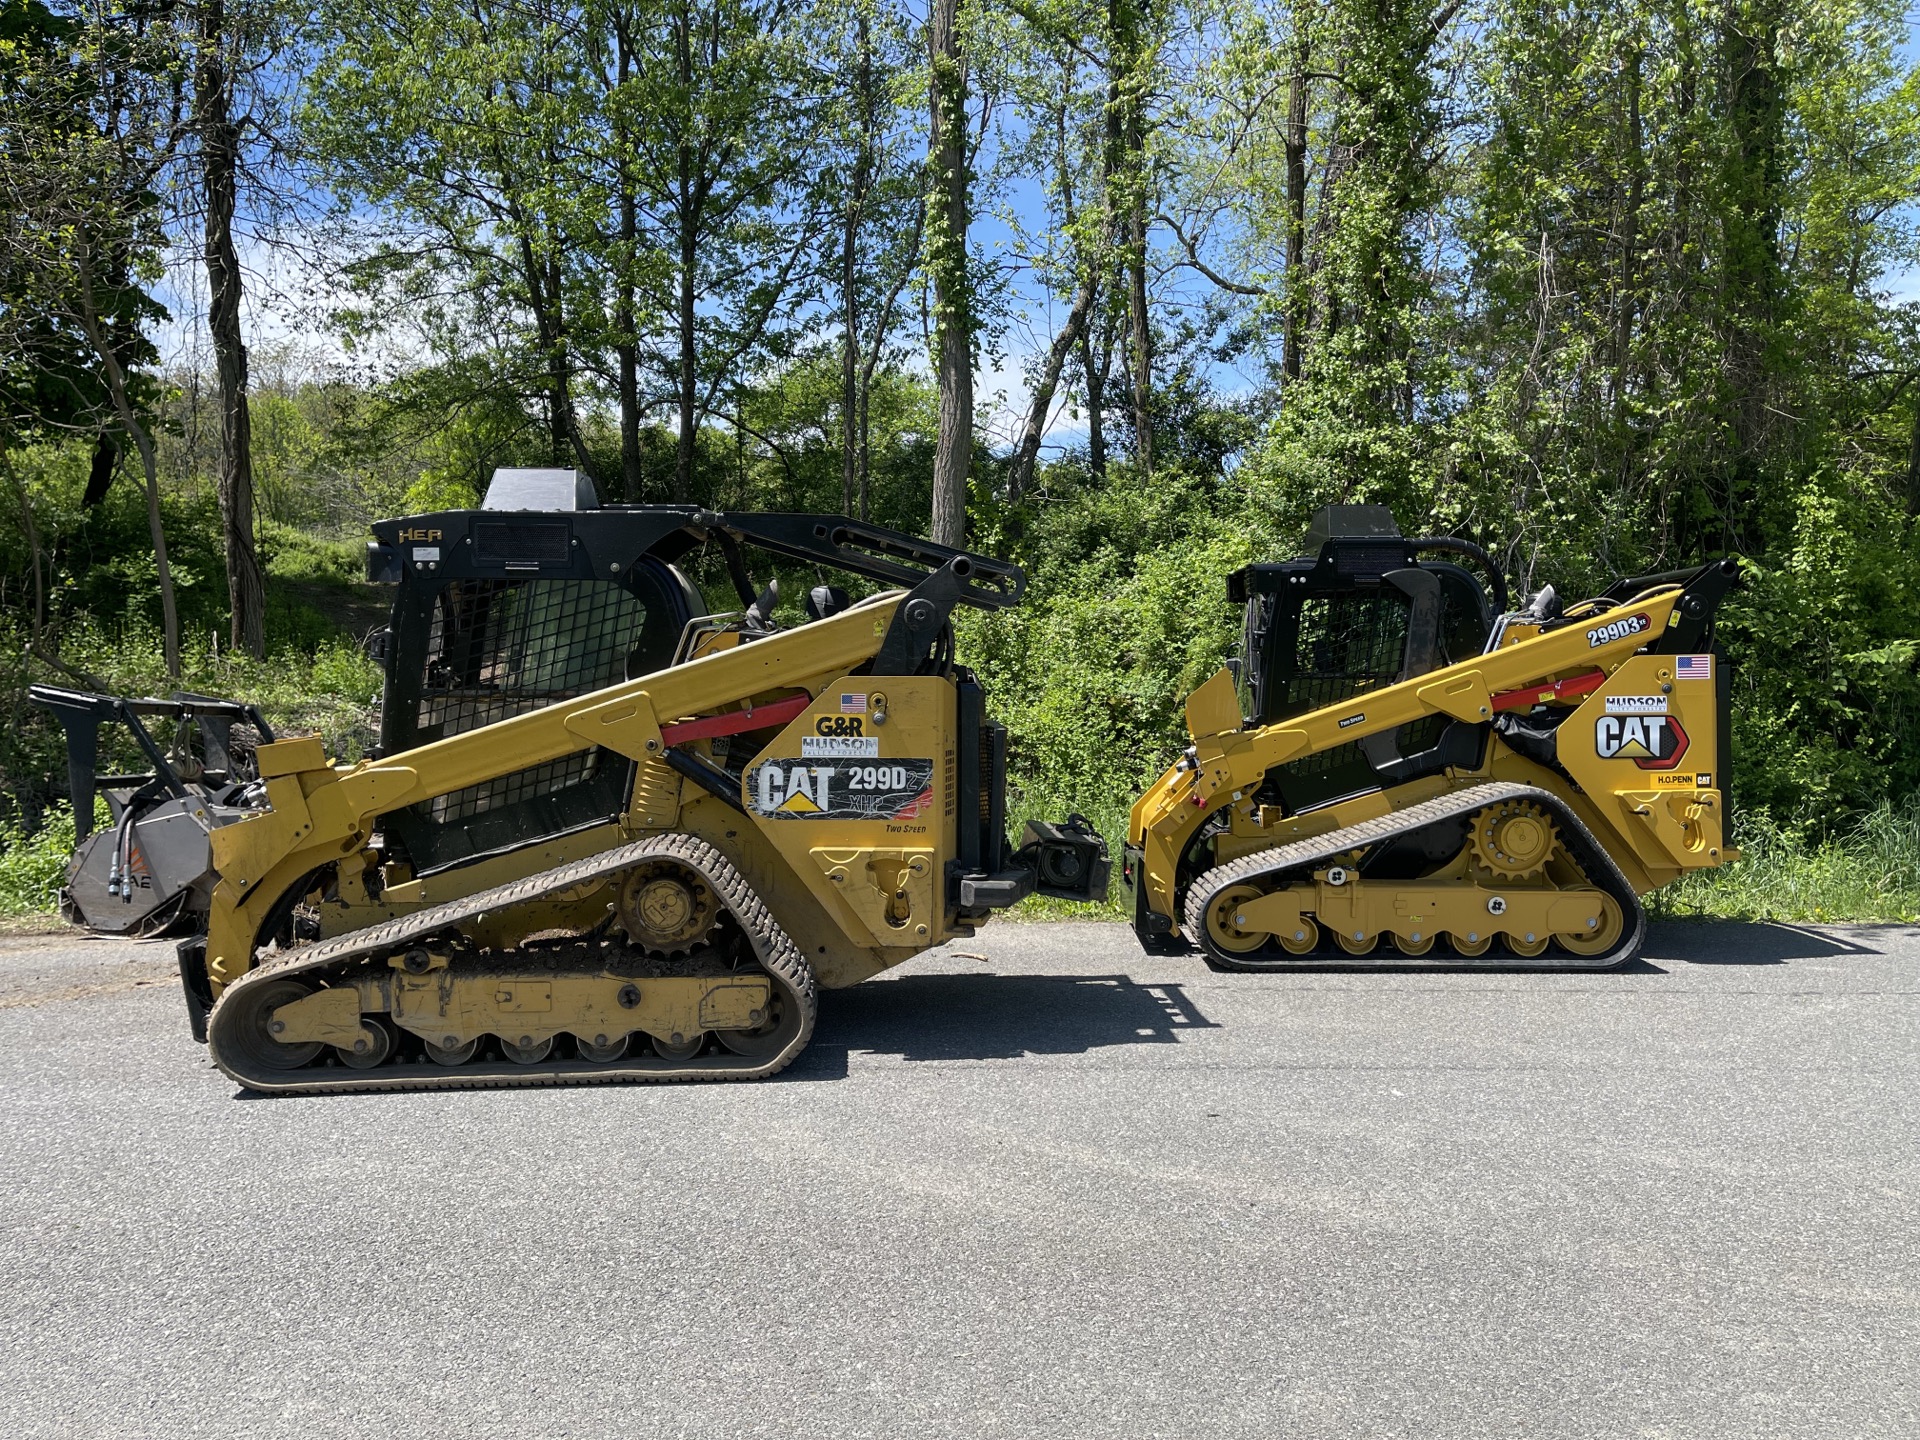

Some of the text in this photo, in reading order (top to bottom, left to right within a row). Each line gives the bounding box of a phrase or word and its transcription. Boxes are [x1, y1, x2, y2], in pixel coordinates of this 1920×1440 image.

[1587, 616, 1641, 648] 299D3
[1606, 697, 1667, 706] HUDSON
[816, 716, 864, 738] G&R
[802, 738, 878, 750] HUDSON
[1596, 716, 1666, 758] CAT
[759, 766, 835, 812] CAT
[1658, 775, 1711, 785] H.O.PENN CAT
[849, 794, 884, 813] XHP
[886, 824, 902, 833] TWO
